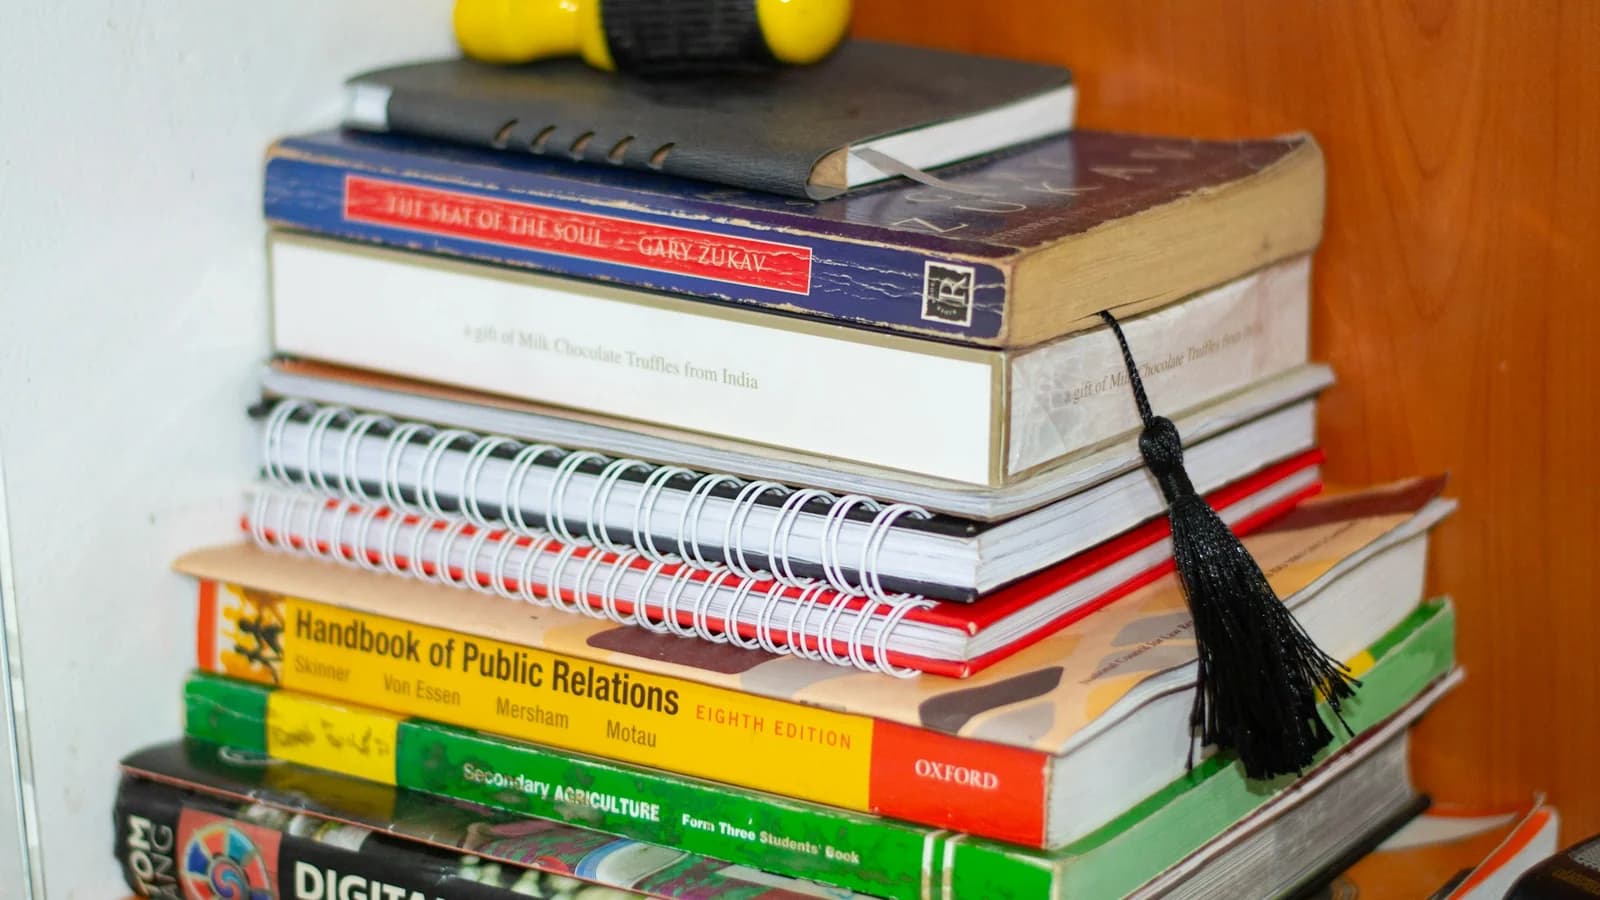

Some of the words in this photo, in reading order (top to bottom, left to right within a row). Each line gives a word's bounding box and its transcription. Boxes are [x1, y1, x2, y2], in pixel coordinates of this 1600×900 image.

[386, 195, 422, 218] THE
[429, 202, 475, 225] SEAT
[477, 209, 503, 230] OF
[507, 214, 550, 239] THE
[552, 221, 603, 248] SOUL
[638, 235, 693, 261] GARY
[698, 245, 766, 272] ZUKAV
[474, 323, 498, 343] gift
[501, 329, 515, 344] of
[518, 331, 551, 351] Milk
[554, 338, 622, 364] Chocolate
[624, 350, 681, 376] Truffles
[683, 360, 719, 383] from
[721, 368, 759, 391] India
[1073, 381, 1094, 404] gift
[1095, 376, 1109, 394] of
[1186, 339, 1220, 362] Truffles
[294, 608, 421, 662] Handbook
[428, 637, 455, 670] of
[461, 640, 545, 688] Public
[551, 660, 682, 717] Relations
[293, 655, 353, 687] Skinner
[382, 671, 413, 697] Von
[415, 679, 463, 708] Essen
[495, 694, 572, 730] Mersham
[605, 717, 659, 749] Motau
[695, 703, 766, 734] EIGHTH
[773, 718, 853, 751] EDITION
[461, 761, 551, 802] Secondary
[553, 784, 661, 823] AGRICULTURE
[913, 757, 1000, 792] OXFORD
[681, 812, 716, 834] Form
[718, 820, 757, 843] Three
[758, 829, 824, 856] Students'
[824, 844, 861, 866] Book
